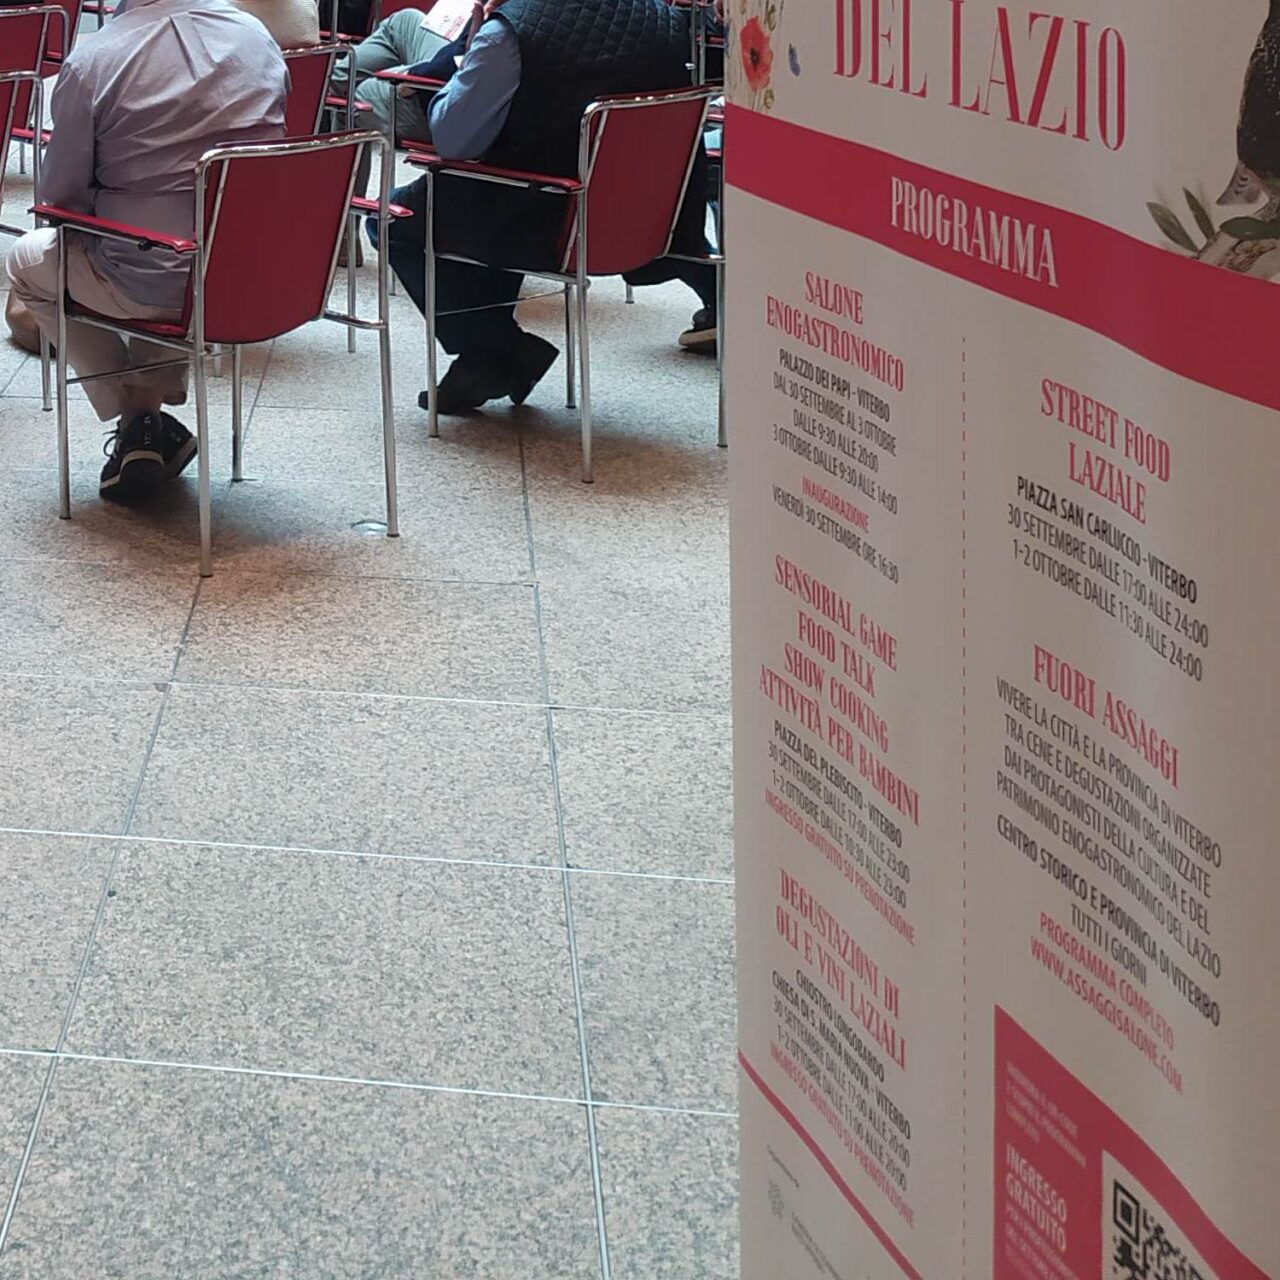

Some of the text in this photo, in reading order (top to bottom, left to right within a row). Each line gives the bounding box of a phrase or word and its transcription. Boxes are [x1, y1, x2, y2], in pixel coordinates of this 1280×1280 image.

[890, 176, 1060, 288] PROGRAMMA
[766, 294, 904, 393] ENOGASTRONOMICO
[805, 271, 863, 325] SALONE
[773, 371, 896, 457] DAL 30 SETTEMBRE AL 3 OTTOBRE
[780, 348, 890, 423] PALAZZO DEI PAPI VITERBO
[793, 408, 879, 473] DALLE 9:30 ALLE 20:00
[1041, 378, 1170, 482] STREET FOOD
[773, 423, 898, 515] 3 OTTOBRE DALLE 9:30 ALLE 14:00
[802, 475, 869, 534] INAUGURAZIONE
[1068, 442, 1146, 525] LAZIALE
[806, 505, 816, 526] 30
[817, 512, 861, 557] SETTEMBRE
[862, 541, 877, 568] ORE
[878, 553, 898, 584] 16:30
[1008, 503, 1209, 648] 30 SETTEMBRE DALLE 17:00 ALLE 24:00
[1017, 475, 1198, 604] PIAZZA SAN CARLUCCIO VITERBO
[775, 554, 897, 672] SENSORIAL GAME
[798, 610, 876, 699] FOOD TALK
[1013, 539, 1203, 682] 1-2 OTTOBRE DALLE 11:30 ALLE 24:00
[759, 663, 920, 827] ATTIVITÀ PER BAMBINI
[784, 642, 889, 754] SHOW COOKING
[1034, 644, 1179, 790] FUORI ASSAGGI
[768, 740, 910, 884] 30 SETTEMBRE DALLE ALLE 23:00
[774, 719, 902, 849] PIAZZA DEL PLEBISCITO VITERBO
[996, 676, 1222, 868] VIVERE LA CITTÀ E LA PROVINCIA DI VITERBO
[1004, 713, 1211, 899] TRA CENE E DEGUSTAZIONI ORGANIZZATE
[772, 769, 906, 909] 1-2 OTTOBRE DALLE ALLE 23:00
[996, 770, 1221, 979] PATRIMONIO ENOGASTRONOMICO DEL LAZIO
[1004, 745, 1211, 936] DAI PROTAGONISTI DELLA CULTURA E DEL
[780, 867, 899, 1020] DEGUSTAZIONI DI
[997, 814, 1220, 1027] CENTRO STORICO E PROVINCIA DI VITERBO
[1039, 911, 1174, 1052] PROGRAMMA COMPLETO
[1071, 903, 1147, 989] TUTTI I GIORNI
[776, 904, 906, 1071] OLI E VINI LAZIALI
[795, 969, 885, 1083] CHIOSTRO LONGOBARDO
[1030, 935, 1184, 1096] WWW.ASSAGGISALONE.COM
[772, 970, 911, 1141] CHIESA MARIA NUOVA VITERBO
[1005, 1172, 1067, 1252] GRATUITO
[1006, 1142, 1067, 1224] INGRESSO
